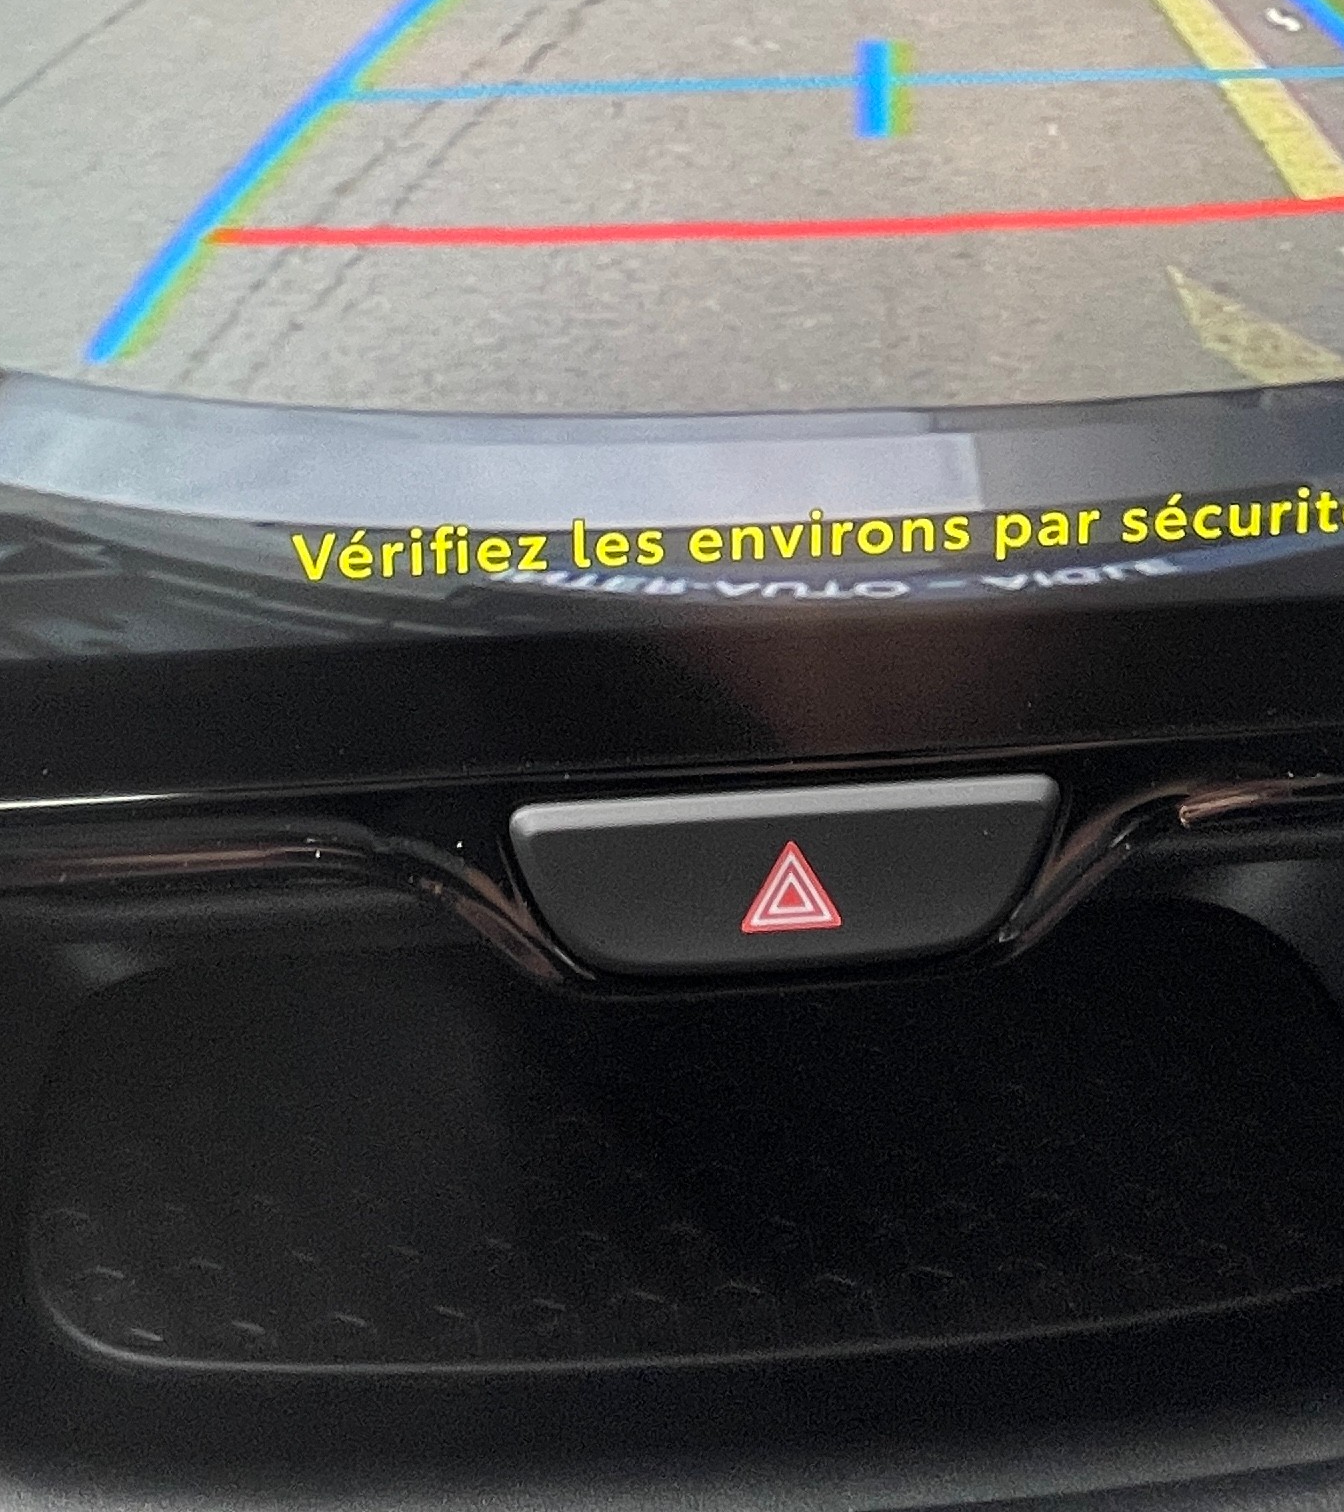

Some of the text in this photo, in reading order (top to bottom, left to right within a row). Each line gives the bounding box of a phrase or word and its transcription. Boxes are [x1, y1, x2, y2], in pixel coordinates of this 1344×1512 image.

[291, 523, 547, 583] Vérifiez
[571, 519, 666, 569] les
[687, 510, 972, 565] environs
[993, 505, 1101, 561] par
